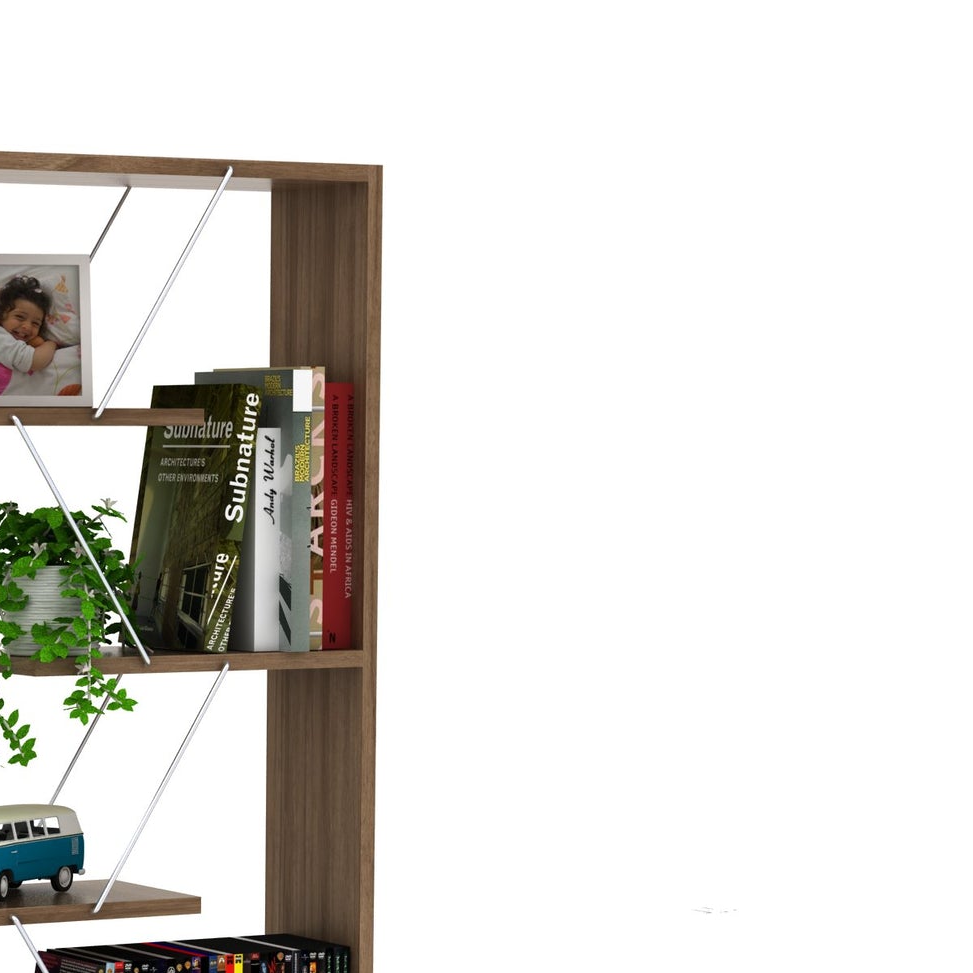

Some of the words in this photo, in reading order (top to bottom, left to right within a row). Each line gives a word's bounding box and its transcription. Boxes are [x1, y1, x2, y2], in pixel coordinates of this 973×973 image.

[160, 458, 206, 467] ARCHITECTURE'S
[224, 392, 260, 523] Subnature
[263, 436, 275, 481] Warhol
[158, 473, 176, 482] OTHER
[177, 474, 219, 483] ENVIRONMENTS
[263, 488, 277, 525] Andy
[345, 553, 352, 562] IN
